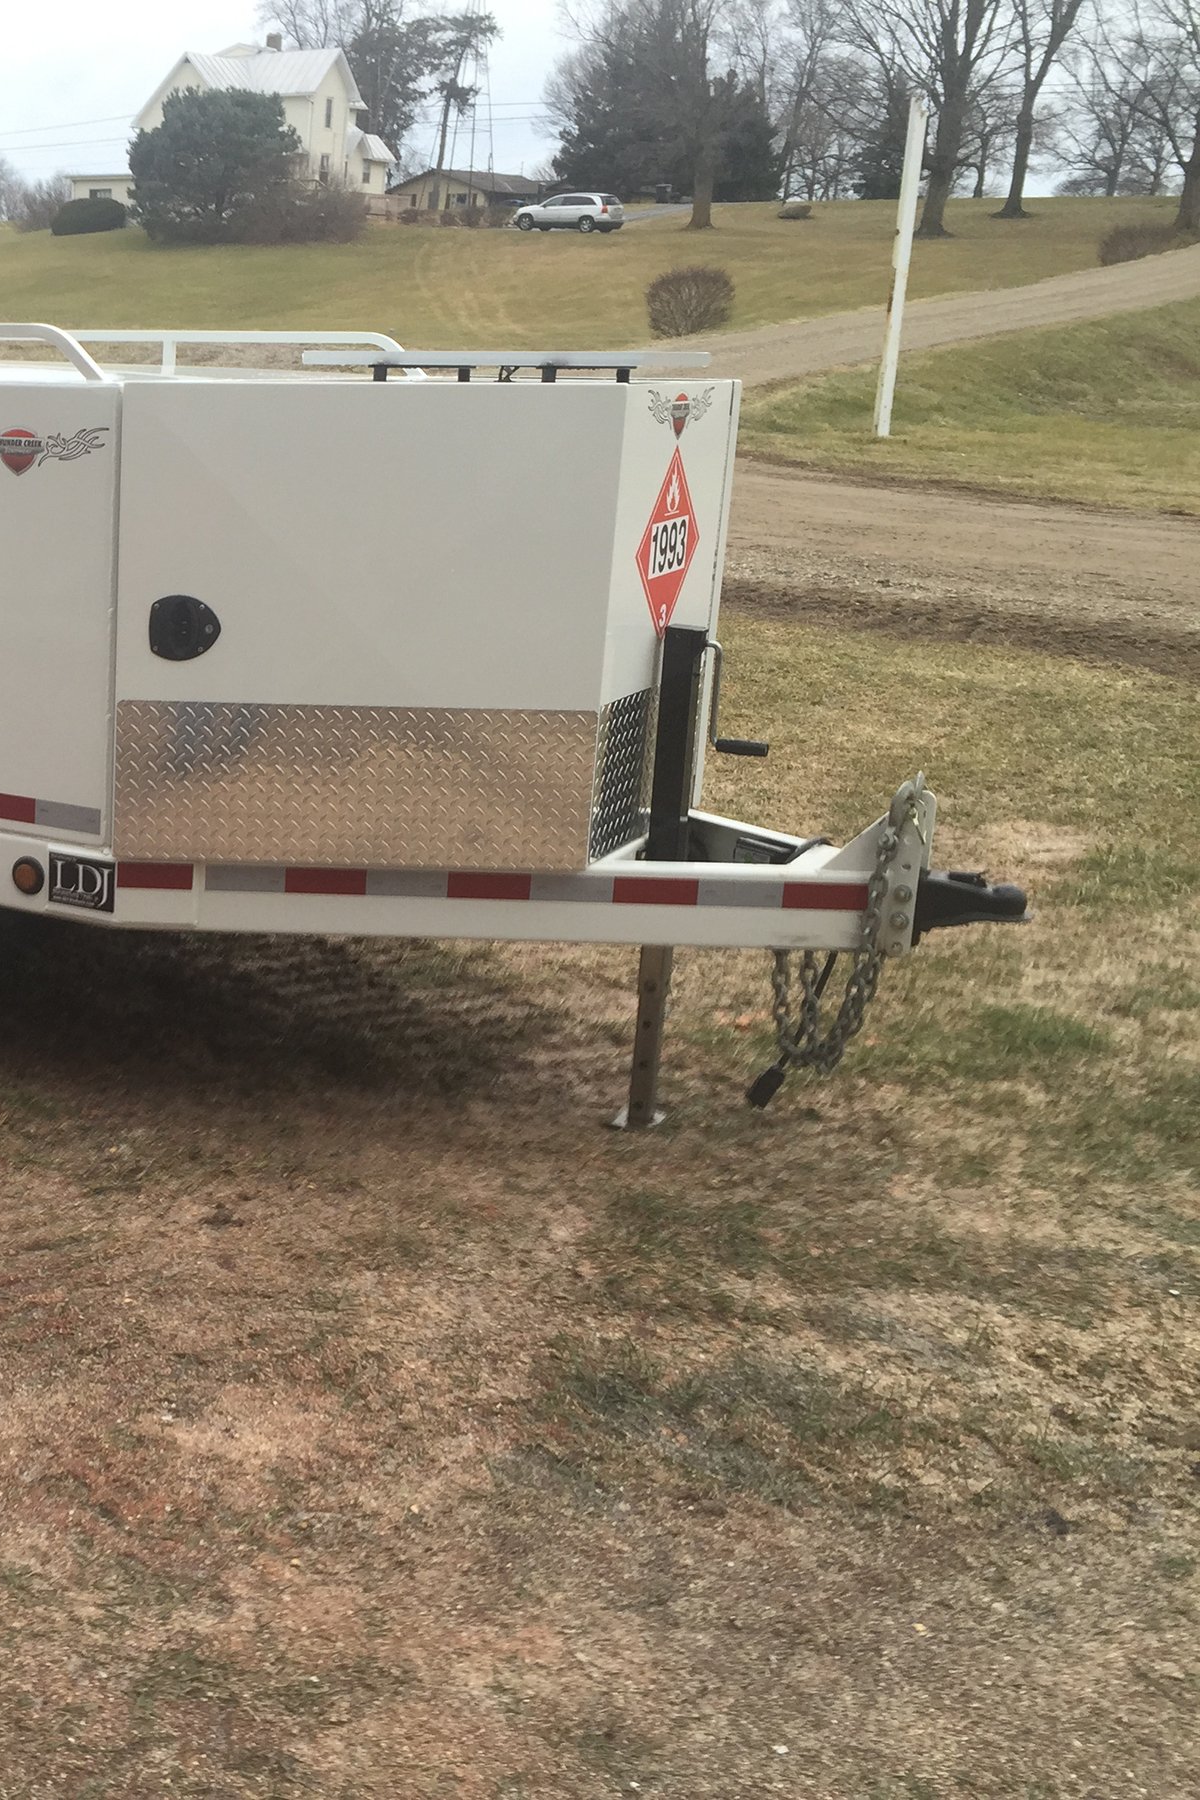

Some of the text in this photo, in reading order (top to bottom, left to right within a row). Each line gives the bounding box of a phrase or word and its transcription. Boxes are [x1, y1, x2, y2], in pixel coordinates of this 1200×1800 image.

[24, 439, 42, 447] CREEK
[652, 519, 687, 574] 1993
[657, 603, 667, 628] 3
[53, 860, 112, 907] LDJ
